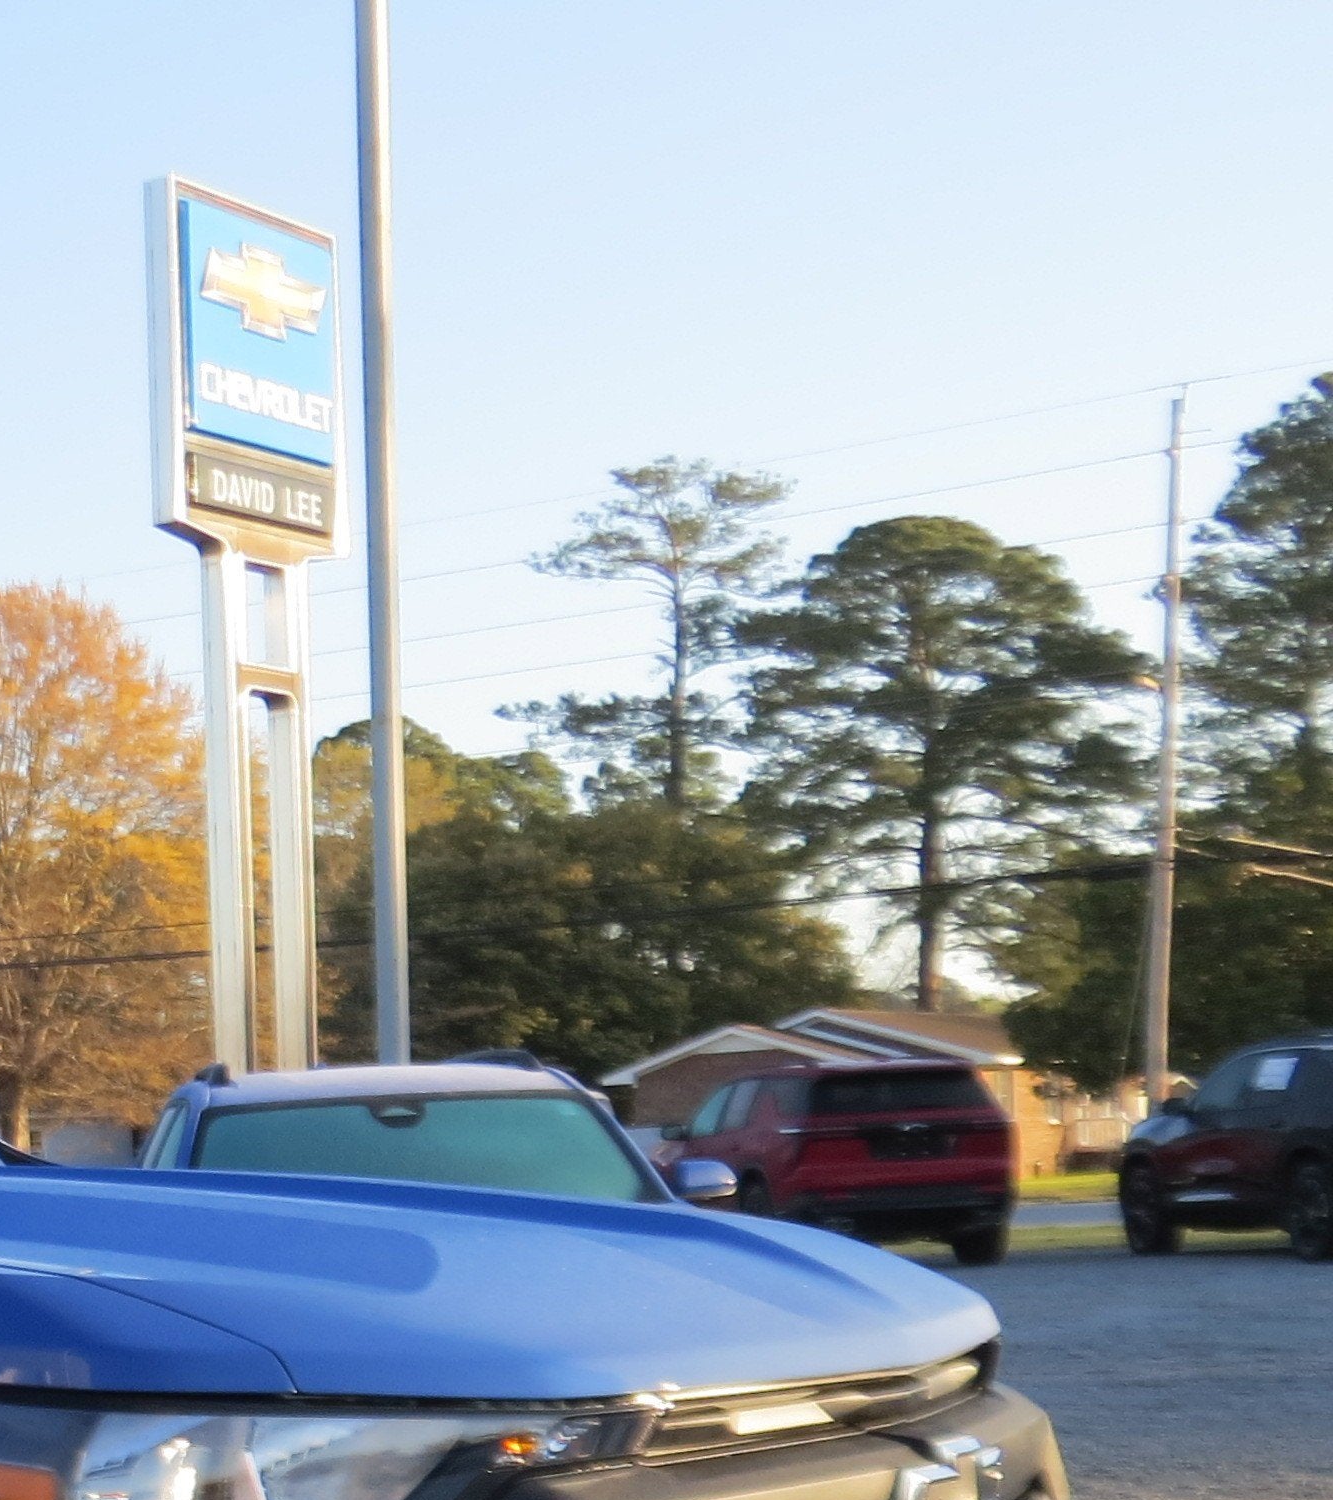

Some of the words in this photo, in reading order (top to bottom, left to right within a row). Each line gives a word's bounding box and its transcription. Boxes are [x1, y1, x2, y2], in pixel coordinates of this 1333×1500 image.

[199, 361, 333, 434] CHEVROLET
[212, 468, 275, 515] DAVID
[285, 486, 324, 527] LEE
